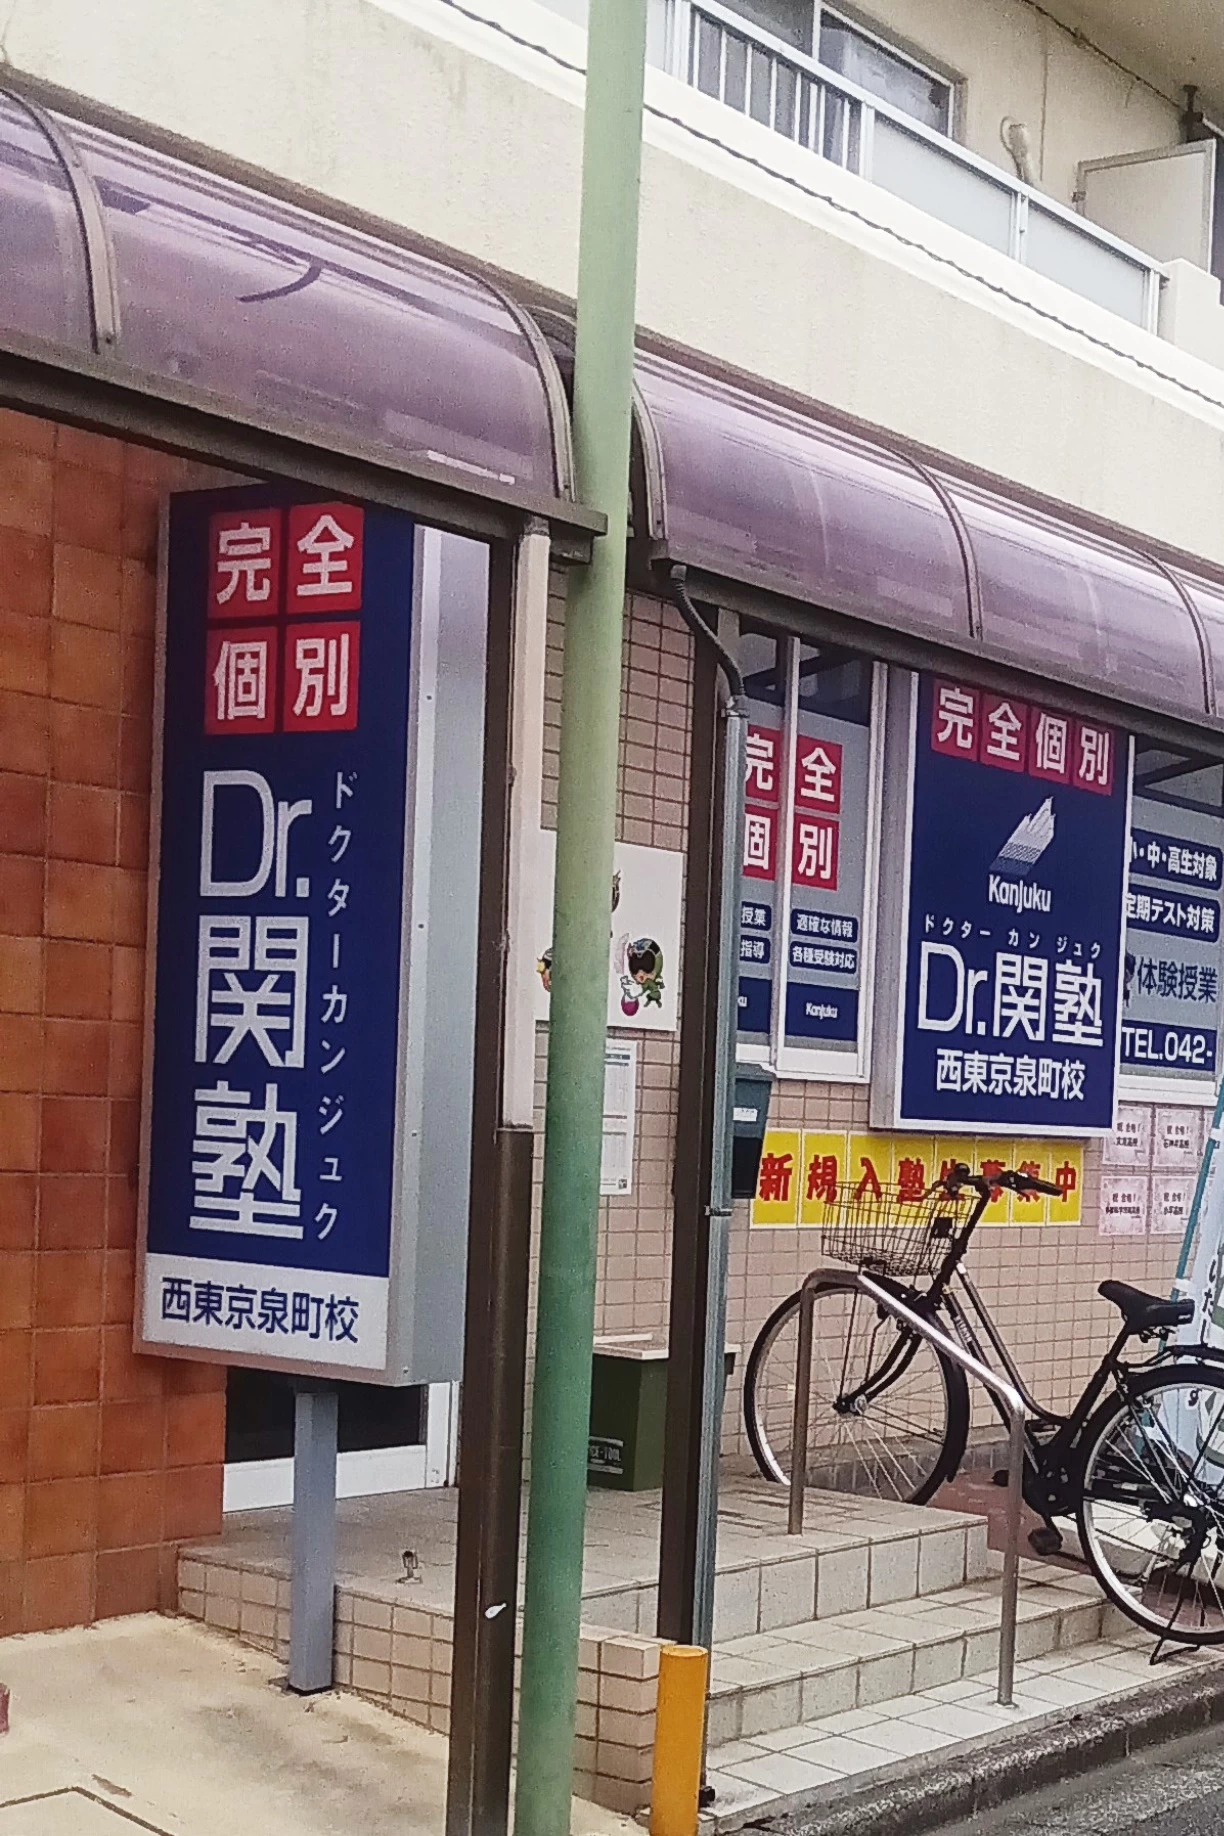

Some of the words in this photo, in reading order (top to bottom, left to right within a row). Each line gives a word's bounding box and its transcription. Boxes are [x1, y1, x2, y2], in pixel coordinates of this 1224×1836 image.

[216, 514, 354, 605] 完全
[213, 633, 350, 720] 個別
[936, 687, 1112, 786] 完全個別
[988, 874, 1052, 914] Kanjuku
[1125, 892, 1216, 934] 定期テスト対策
[793, 945, 856, 970] 各種受験対応
[925, 914, 991, 939] ドクター
[1009, 928, 1040, 949] カン
[1056, 936, 1101, 959] ジュク
[314, 770, 358, 1241] ドクターカンジュク
[917, 940, 1104, 1048] Dr.関塾
[1137, 956, 1218, 1003] 体験授業
[937, 1048, 1086, 1101] 西東京泉町校
[161, 1276, 360, 1344] 西東京泉町校
